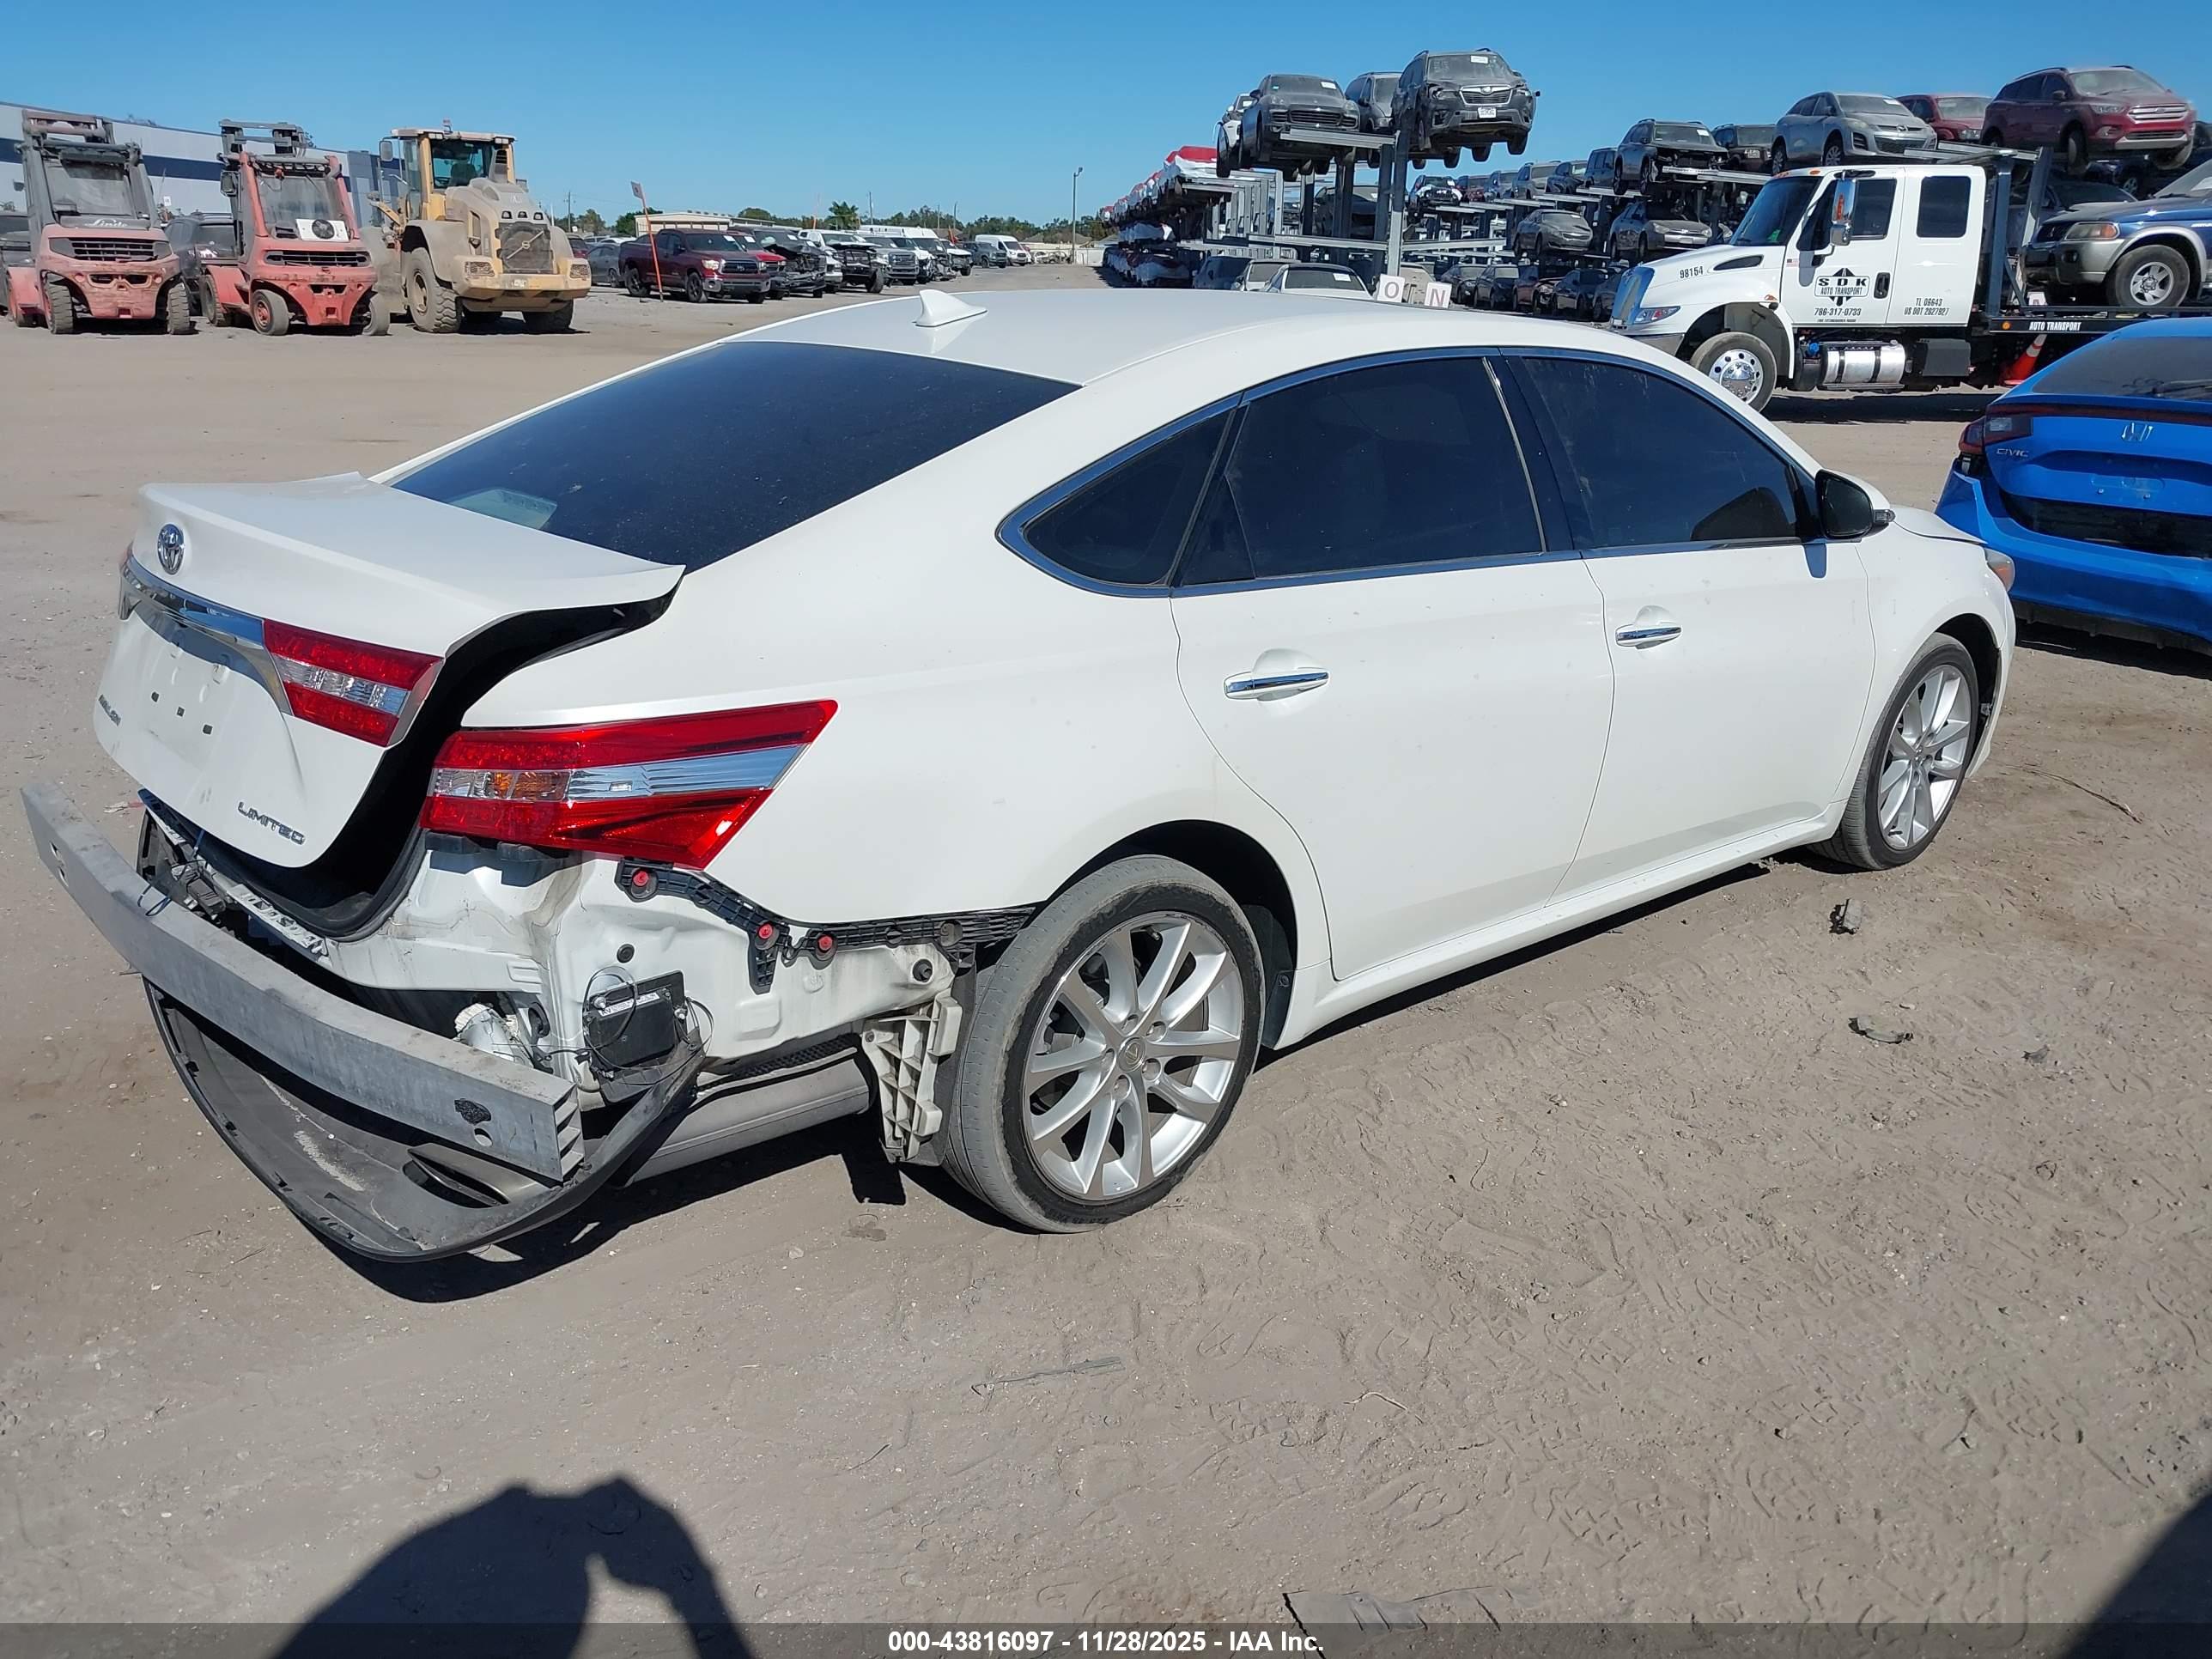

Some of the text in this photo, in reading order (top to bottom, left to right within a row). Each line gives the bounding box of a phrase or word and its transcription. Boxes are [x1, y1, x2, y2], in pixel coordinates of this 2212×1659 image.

[1680, 265, 1704, 279] 98154
[1820, 287, 1863, 296] AUTO TRANSPORT
[1428, 288, 1446, 307] N
[1915, 297, 1943, 307] TL 06643
[1814, 307, 1862, 316] 786-317-0733
[1904, 307, 1950, 316] US DOT 2627927
[2028, 321, 2081, 331] AUTO TRANSPORT
[1996, 448, 2030, 458] CIVIC
[237, 801, 305, 845] LIMITED
